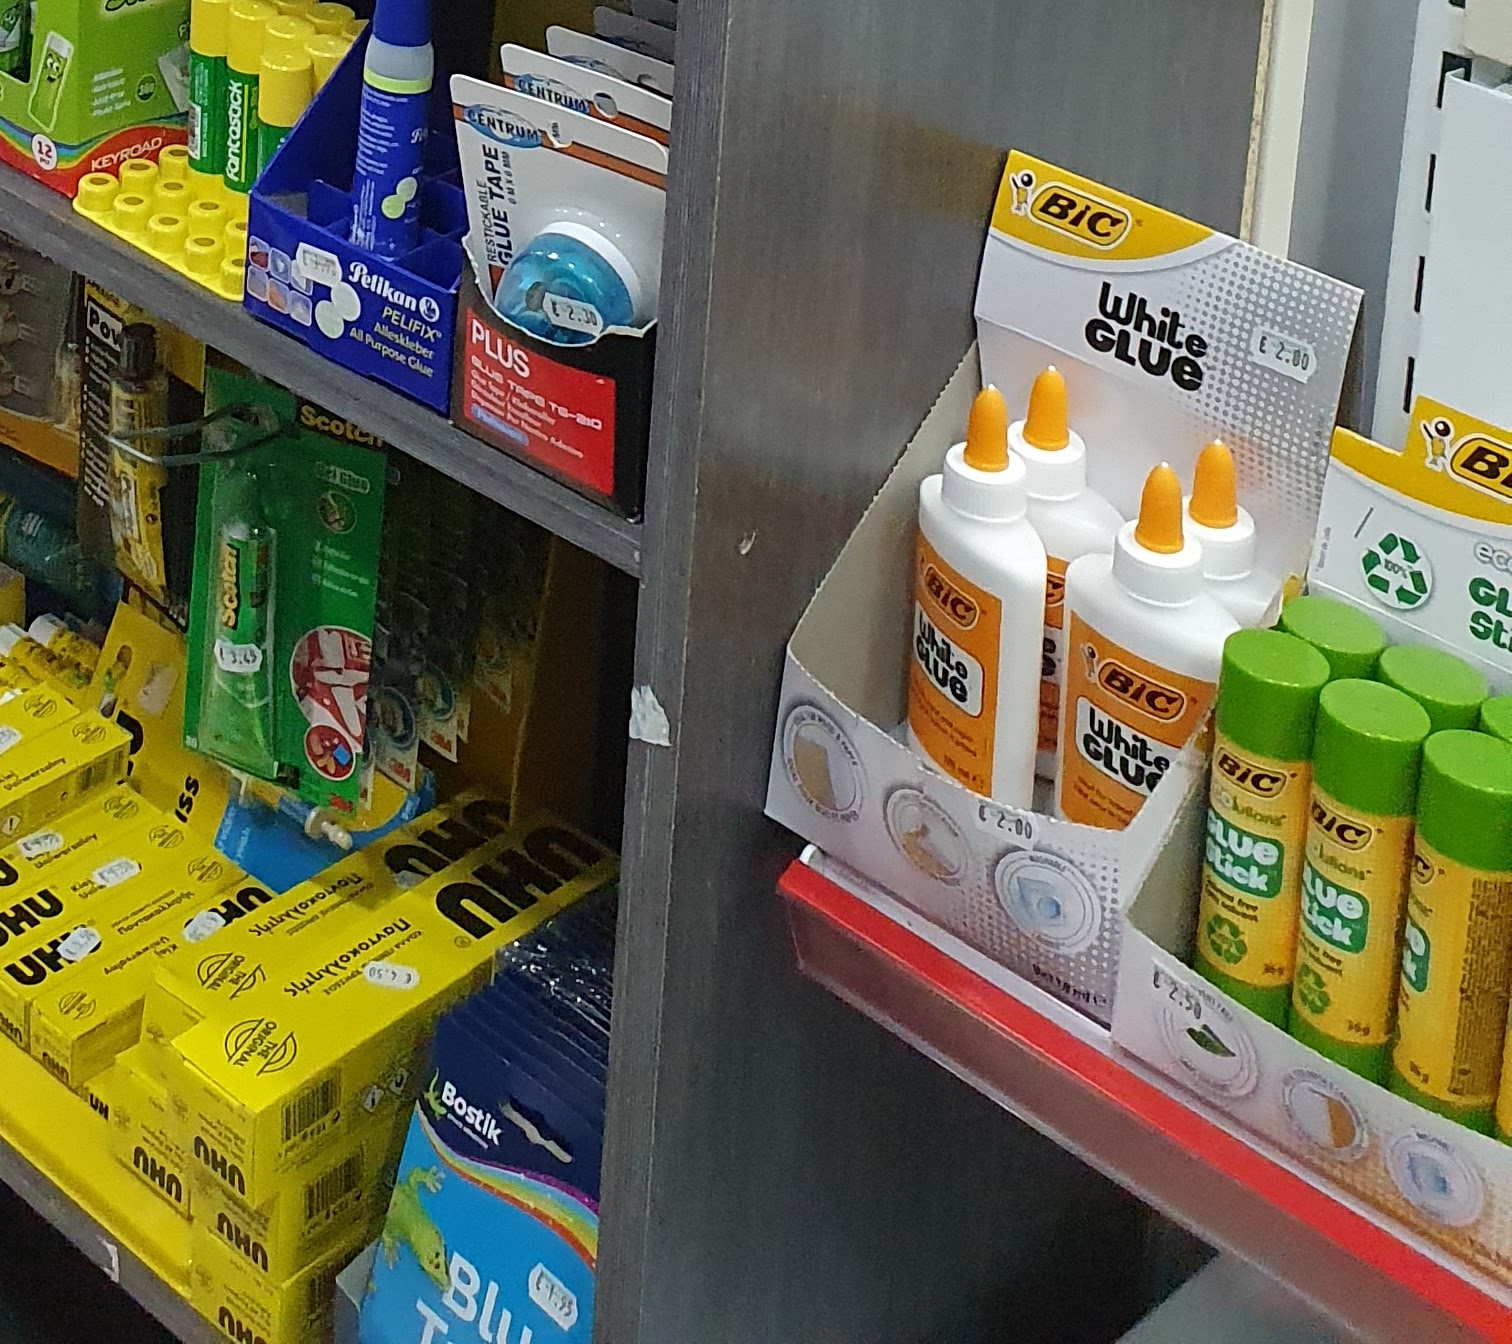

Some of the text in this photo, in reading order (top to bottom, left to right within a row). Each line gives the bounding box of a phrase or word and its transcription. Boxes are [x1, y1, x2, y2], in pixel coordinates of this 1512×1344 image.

[36, 137, 53, 158] 12
[467, 108, 541, 141] CENTRUM
[90, 136, 164, 173] KEYROAD
[482, 143, 506, 201] TAPE
[475, 179, 498, 263] RESTICKABLE
[490, 207, 514, 266] GLUE
[1038, 192, 1126, 239] BIC
[348, 260, 418, 312] Pelikan
[374, 321, 435, 360] Alleskleber
[1098, 280, 1208, 358] White
[349, 326, 435, 378] All Purpose Glue
[471, 317, 531, 379] PLUS
[1275, 340, 1310, 372] 2.00
[299, 405, 385, 449] Scotch
[219, 543, 238, 628] Scotch
[927, 576, 974, 624] BIC
[1104, 667, 1179, 714] BIC
[1089, 706, 1170, 773] White
[1218, 753, 1282, 794] BIC
[997, 811, 1033, 839] 2.00
[1311, 800, 1366, 845] BIC
[435, 825, 602, 940] UHU
[3, 924, 103, 986] UH
[237, 1020, 279, 1070] ORIGINAL
[441, 1080, 503, 1147] Bostik
[132, 1144, 183, 1204] UHU
[192, 1134, 248, 1198] UHU
[216, 1210, 270, 1274] UHU
